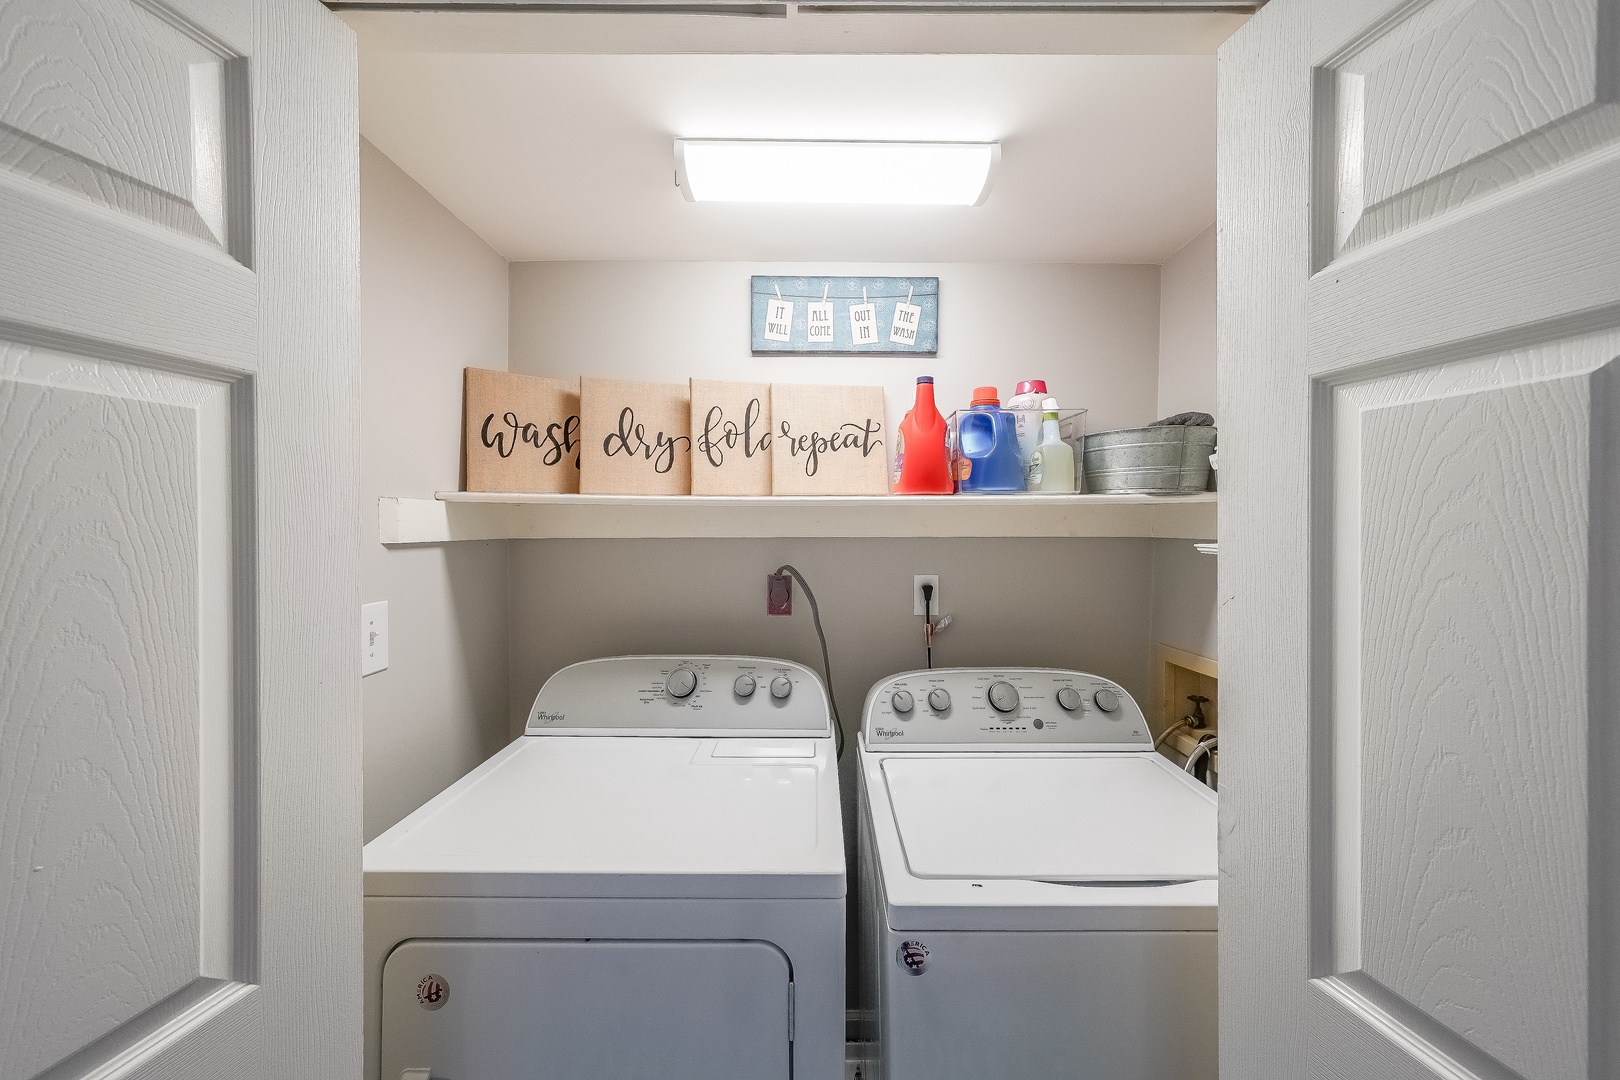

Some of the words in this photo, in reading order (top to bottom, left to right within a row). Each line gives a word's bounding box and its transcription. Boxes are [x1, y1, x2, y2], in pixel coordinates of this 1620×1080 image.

[775, 306, 785, 320] IT
[812, 310, 829, 322] ALL
[854, 309, 871, 323] OUT
[898, 310, 915, 324] THE
[768, 322, 788, 336] WILL
[809, 325, 831, 337] COME
[859, 326, 871, 339] IN
[893, 325, 915, 340] WASH
[604, 405, 691, 474] dry
[778, 418, 883, 477] repeat
[537, 713, 565, 722] Whirlpool
[876, 730, 904, 738] Whirlpool
[416, 975, 434, 1005] AMERICA
